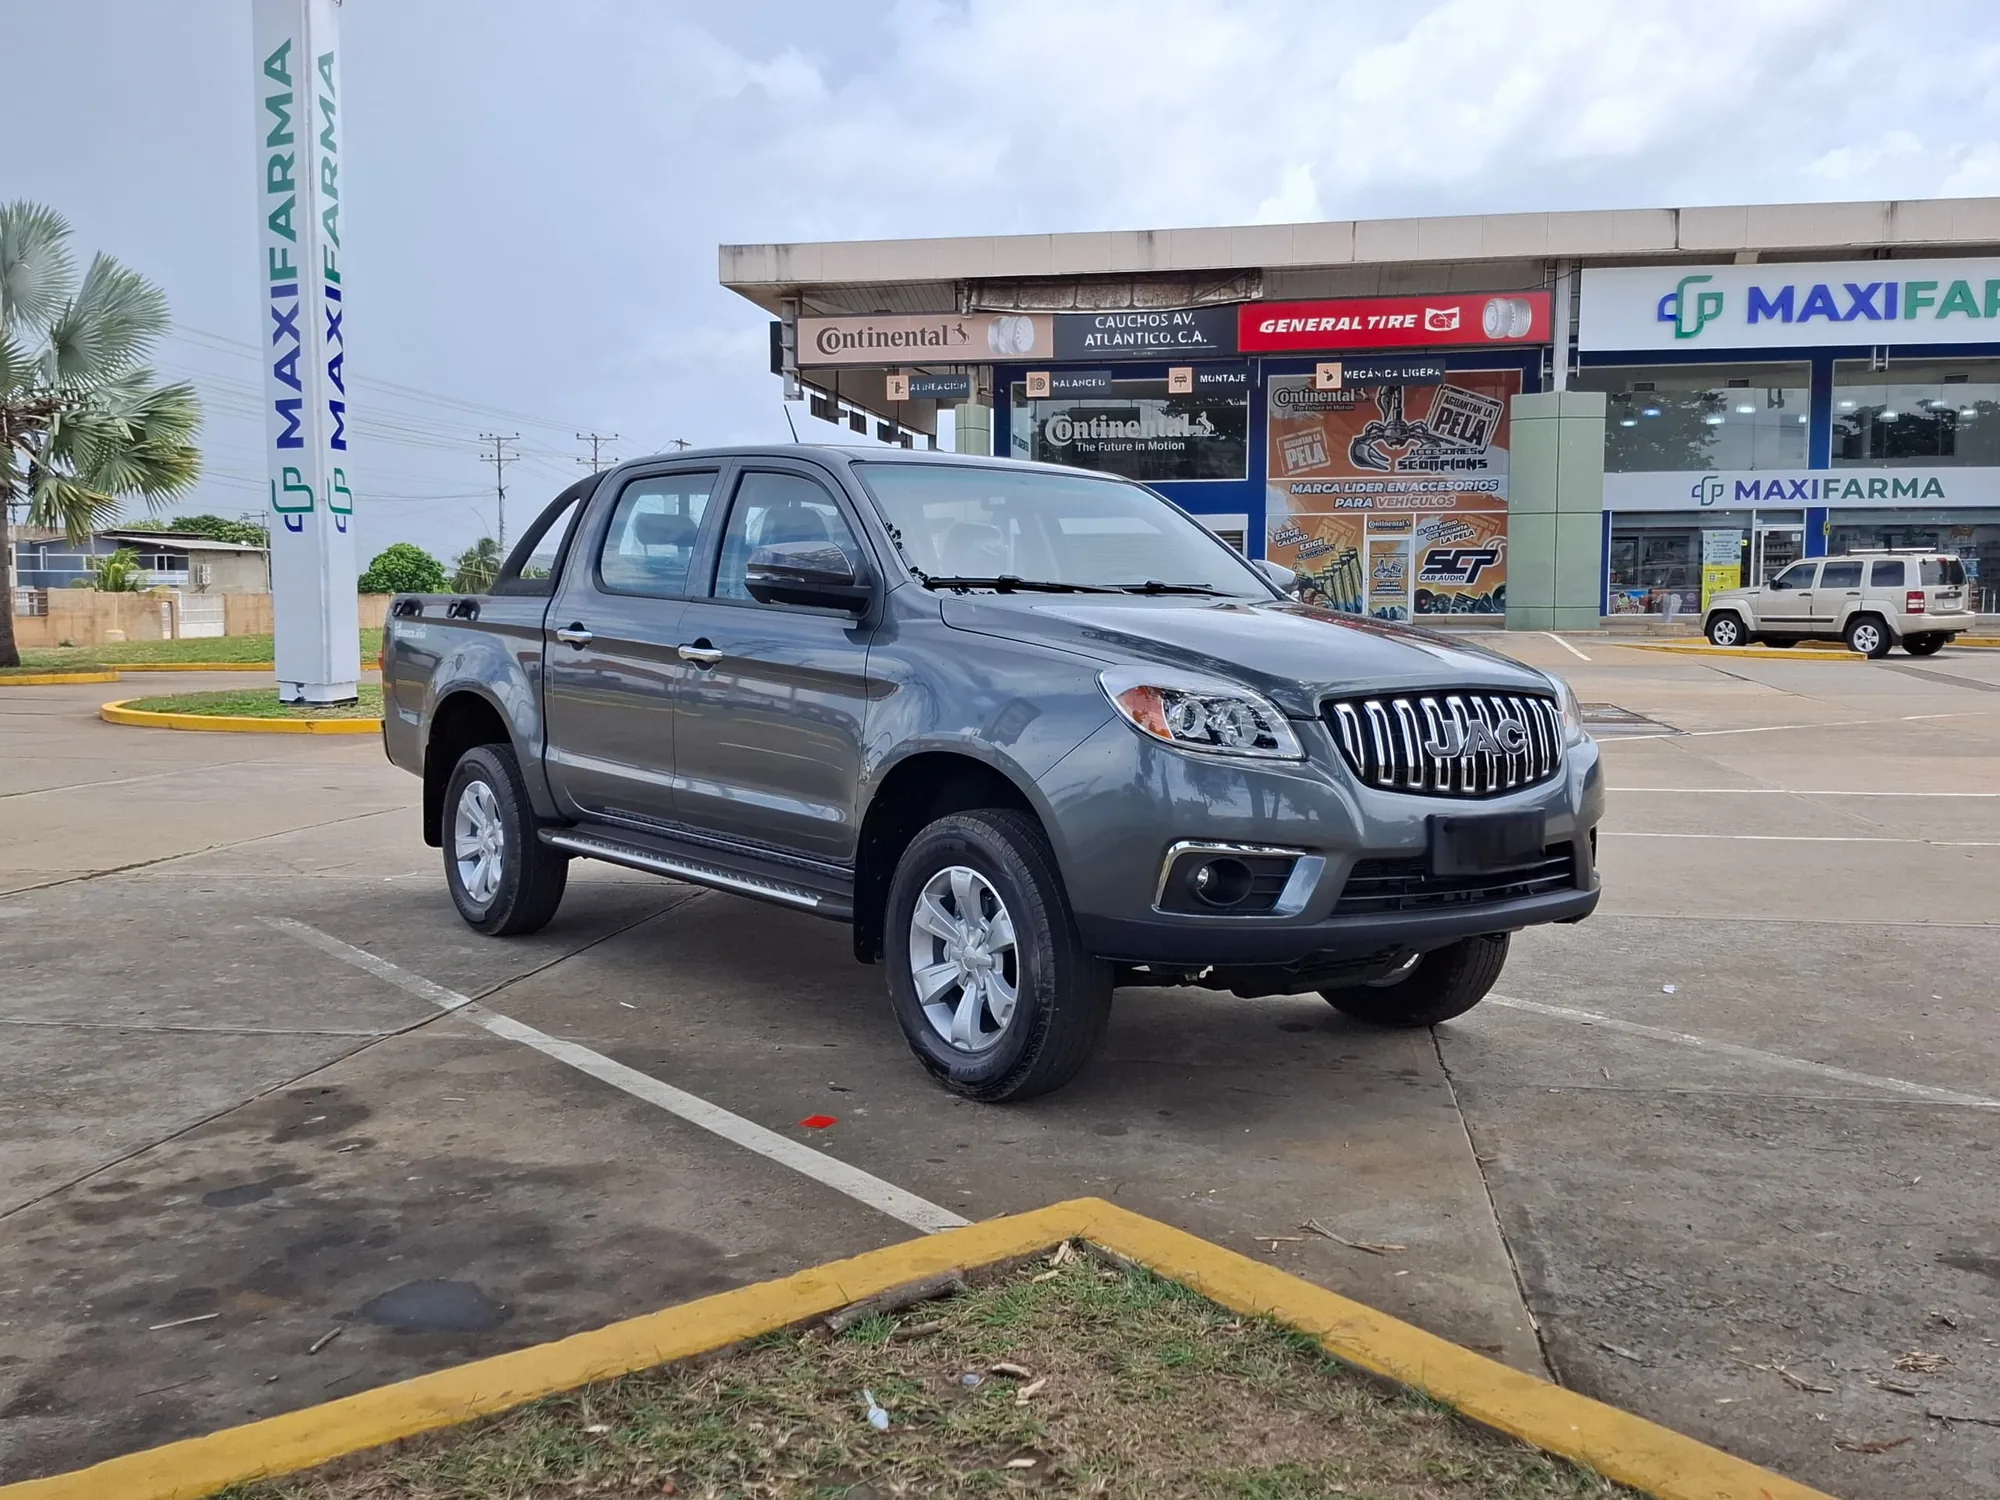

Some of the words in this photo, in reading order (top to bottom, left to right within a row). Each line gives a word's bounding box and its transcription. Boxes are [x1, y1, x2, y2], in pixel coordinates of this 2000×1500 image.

[263, 37, 305, 449] MAXIFARMA
[316, 50, 348, 451] MAXIFARMA
[1095, 313, 1168, 329] CAUCHOS
[1172, 312, 1195, 326] AV.
[1258, 316, 1361, 334] GENERAL
[1366, 314, 1418, 330] TIRE
[816, 324, 949, 356] Continental
[1178, 330, 1207, 344] C.A.
[1199, 373, 1247, 384] MONTAJE
[1344, 366, 1399, 379] MECÁNICA
[1402, 367, 1441, 378] LIGERA
[1273, 387, 1356, 407] Continental
[1443, 395, 1482, 414] AGUANTAN
[1483, 407, 1494, 419] LA
[1045, 413, 1191, 447] Continental
[1433, 407, 1487, 446] PELA
[1076, 442, 1096, 452] The
[1098, 442, 1133, 451] Future
[1148, 441, 1185, 451] Motion
[1285, 443, 1326, 469] PELA
[1397, 457, 1488, 472] SCORPIONS
[1290, 482, 1340, 495] MARCA
[1343, 481, 1383, 494] LIDER
[1386, 481, 1407, 493] EN
[1408, 480, 1498, 492] ACCESORIOS
[1734, 477, 1946, 501] MAXIFARMA
[1334, 496, 1372, 508] PARA
[1376, 494, 1455, 508] VEHÍCULOS
[1275, 527, 1300, 541] EXIGE
[1277, 534, 1309, 547] CALIDAD
[1440, 537, 1452, 545] LA
[1453, 530, 1475, 542] PELA
[1299, 538, 1324, 551] EXIGE
[1425, 719, 1528, 757] JAC
